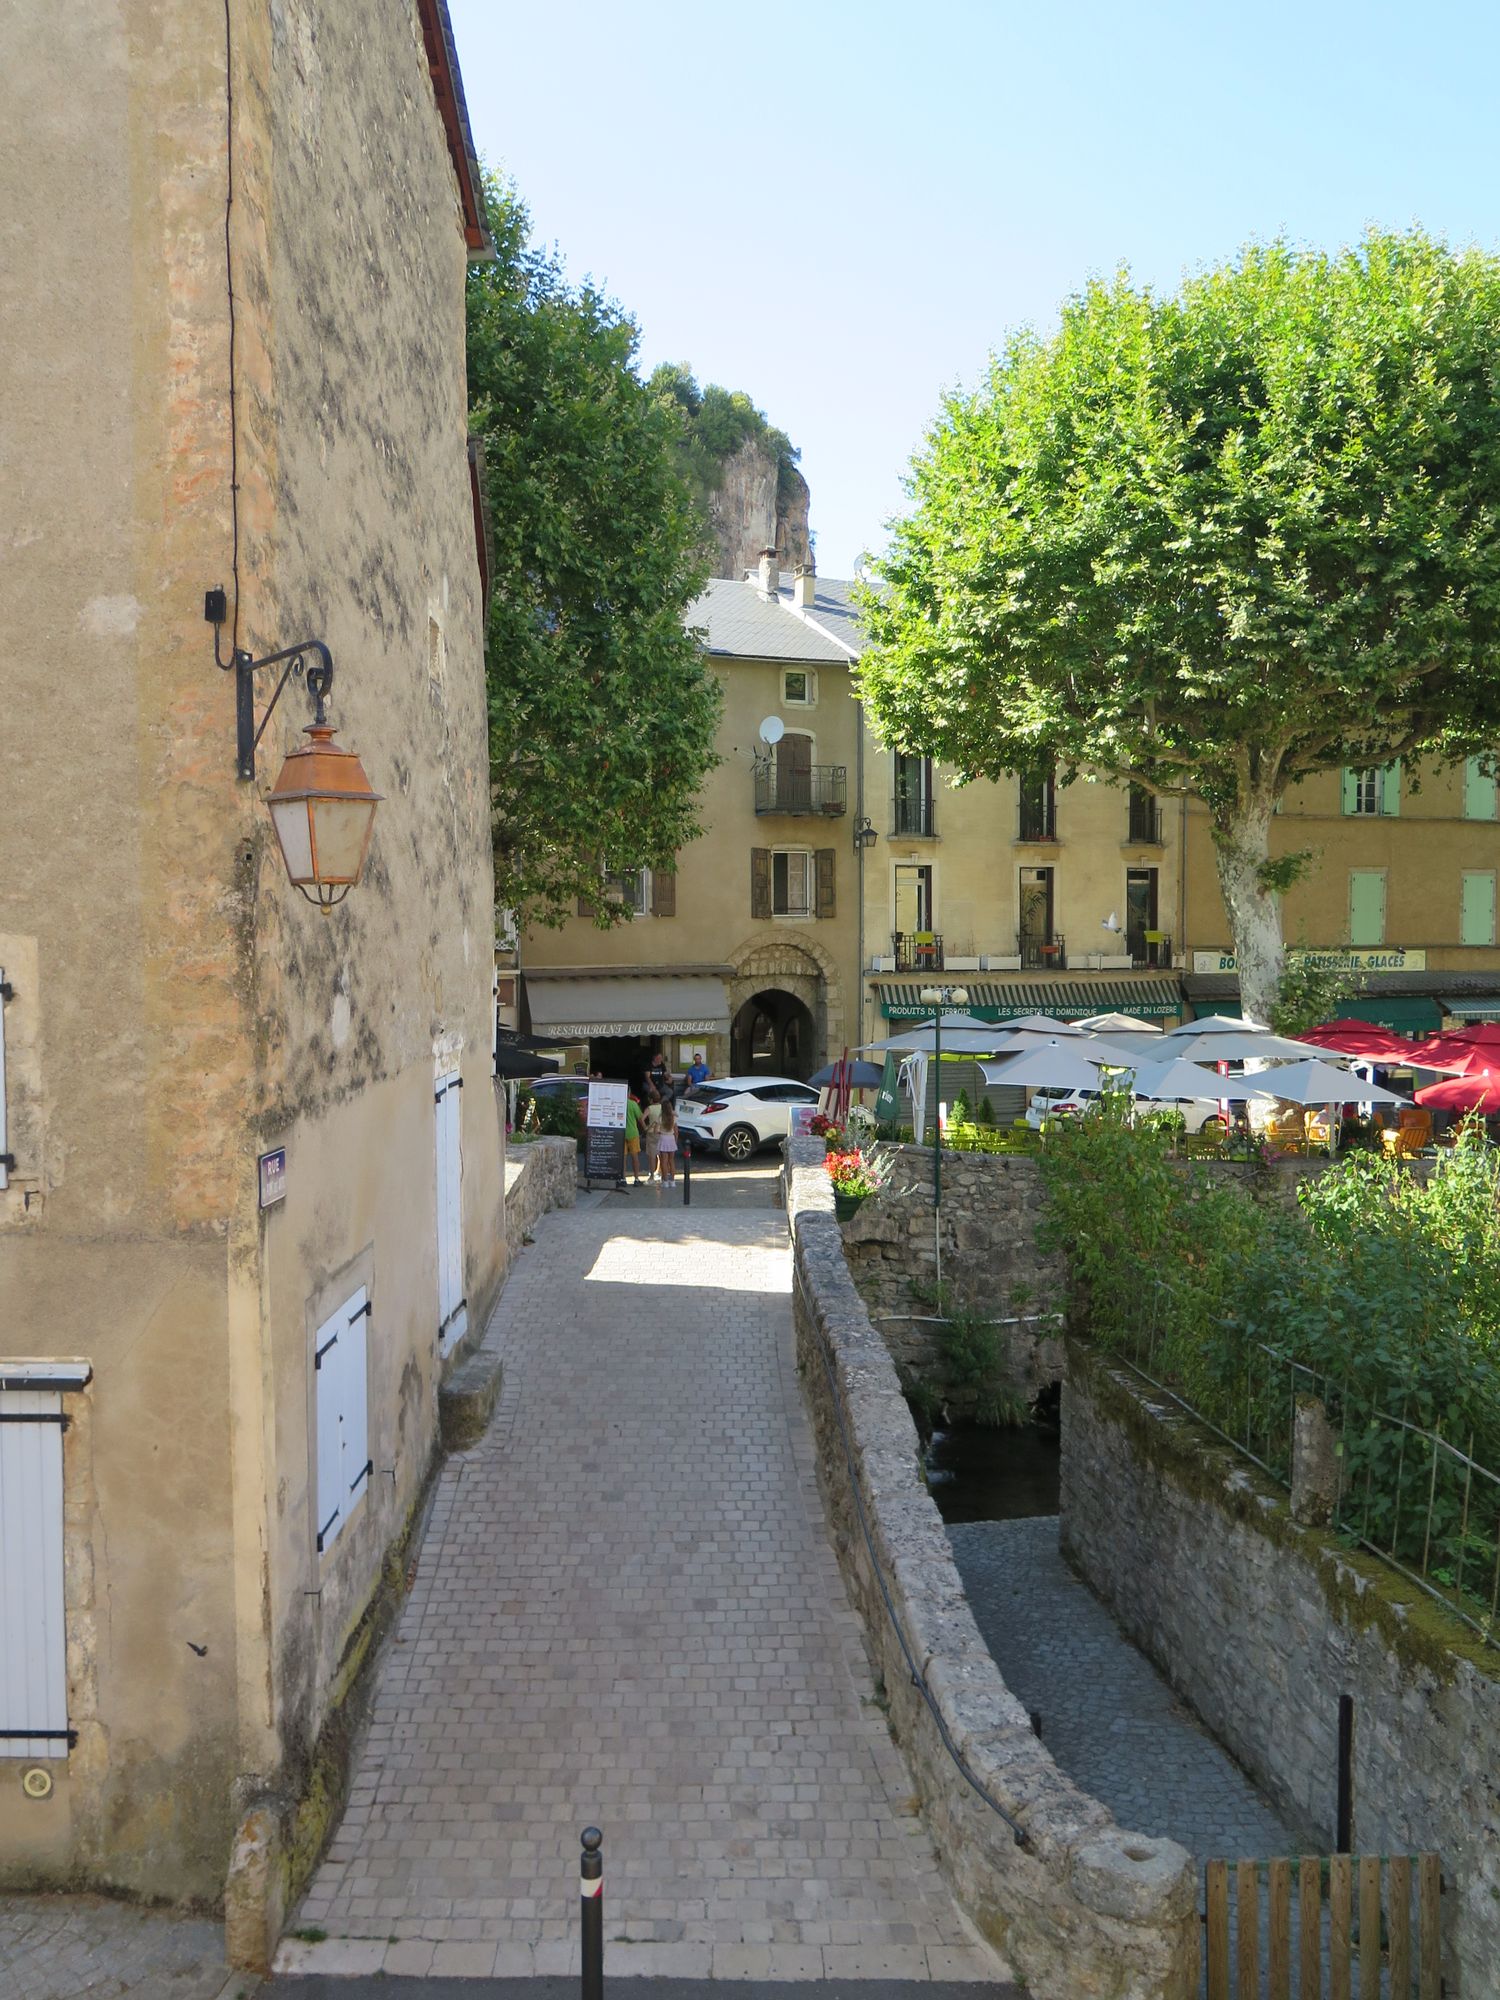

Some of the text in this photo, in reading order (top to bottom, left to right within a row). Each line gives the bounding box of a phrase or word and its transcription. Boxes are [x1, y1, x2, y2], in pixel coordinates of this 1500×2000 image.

[1367, 955, 1405, 968] GLACES
[888, 1006, 925, 1015] PRODUITS
[998, 1007, 1097, 1017] LES SECRETS DE DOMINIQUE
[1122, 1006, 1141, 1015] MADE
[1143, 1006, 1152, 1014] IN
[548, 1020, 717, 1036] RESTAURANT LA CARDABELLE
[267, 1157, 280, 1176] RUE
